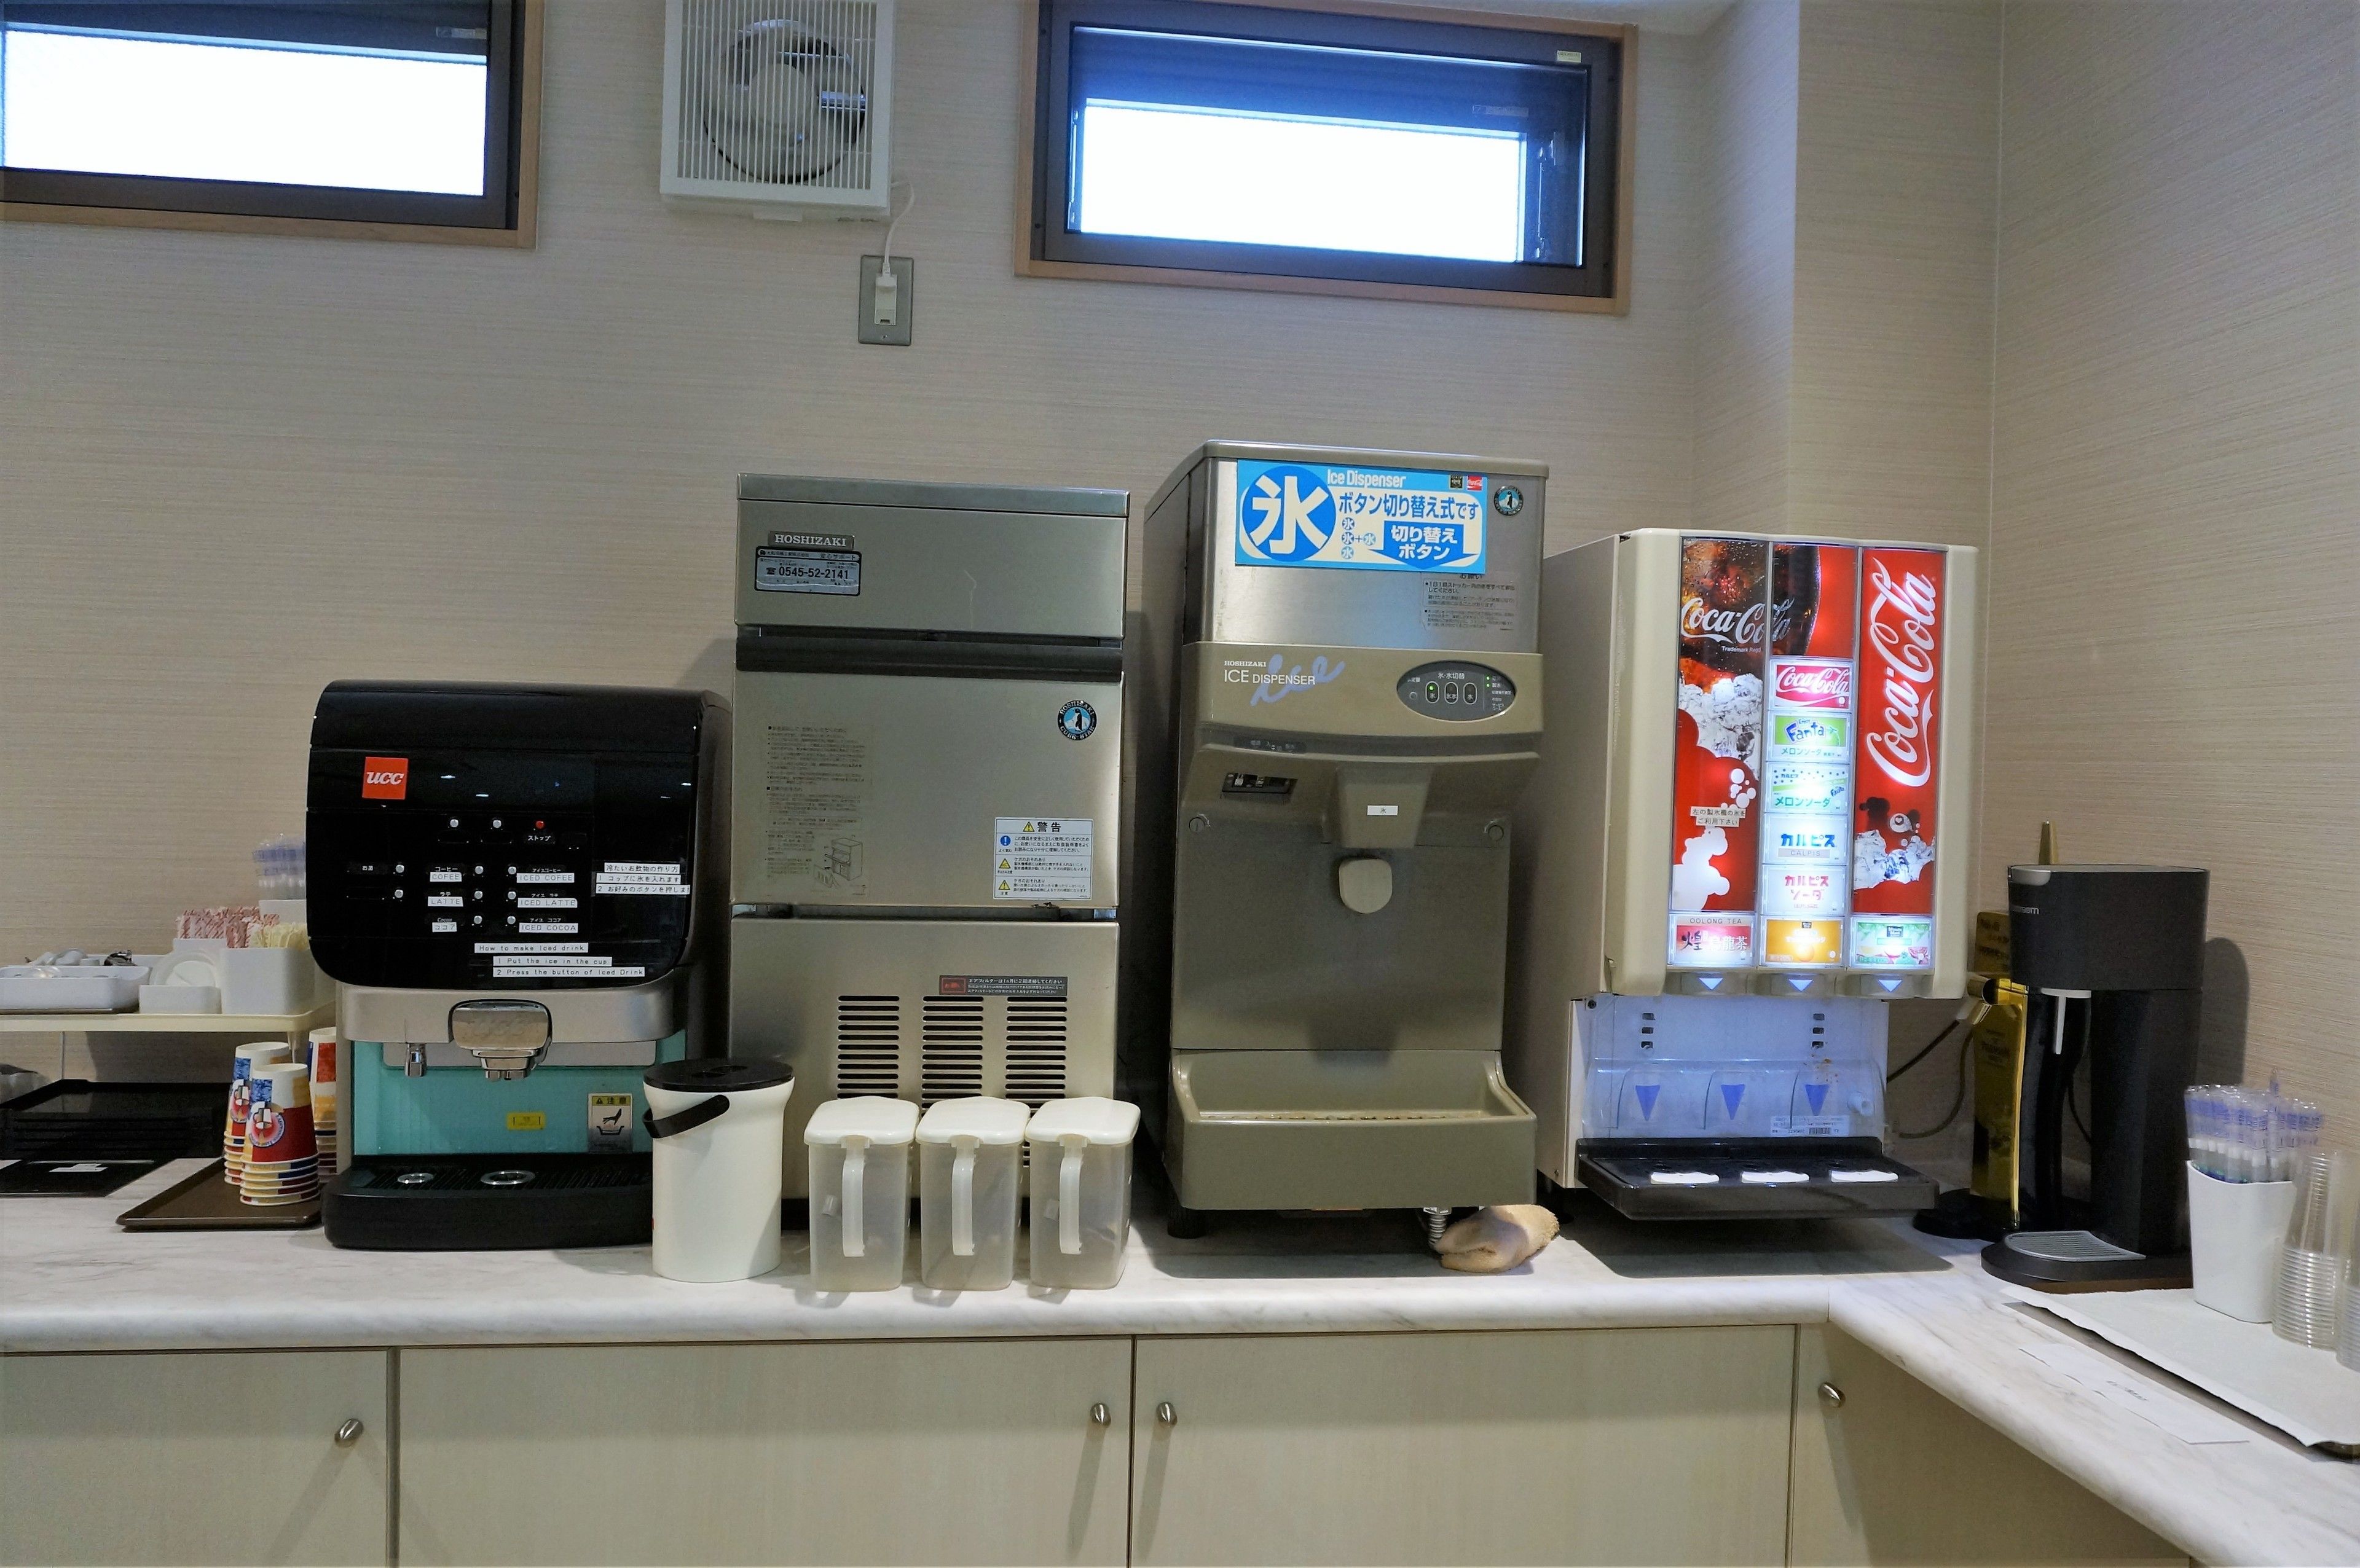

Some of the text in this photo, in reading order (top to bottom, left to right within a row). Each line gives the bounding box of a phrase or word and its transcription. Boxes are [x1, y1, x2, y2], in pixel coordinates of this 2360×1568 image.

[1328, 469, 1406, 489] Ice Dispenser
[1339, 492, 1479, 520] ボタン切り替え式です
[1250, 474, 1329, 555] 氷
[1342, 517, 1355, 530] 氷
[774, 534, 847, 547] HOSHIZAKI
[1391, 525, 1458, 544] 切り替え
[1342, 547, 1354, 559] 水
[1399, 544, 1450, 560] ボタン
[779, 566, 849, 579] 0545-52-2141
[1681, 597, 1795, 644] Coca-Cola
[1224, 669, 1316, 685] ICE DISPENSER
[1866, 557, 1937, 787] Coca-Cola
[1777, 666, 1850, 696] Coca-Cola
[1060, 700, 1095, 715] HOSHIZAKI
[1785, 722, 1825, 742] Fanta
[1781, 747, 1822, 756] メロンソーダ
[1774, 796, 1831, 808] メロンソーダ
[1037, 821, 1061, 833] 警告
[1780, 833, 1836, 848] カルピス
[1785, 875, 1830, 887] カルピス
[1790, 888, 1825, 901] ソーダ
